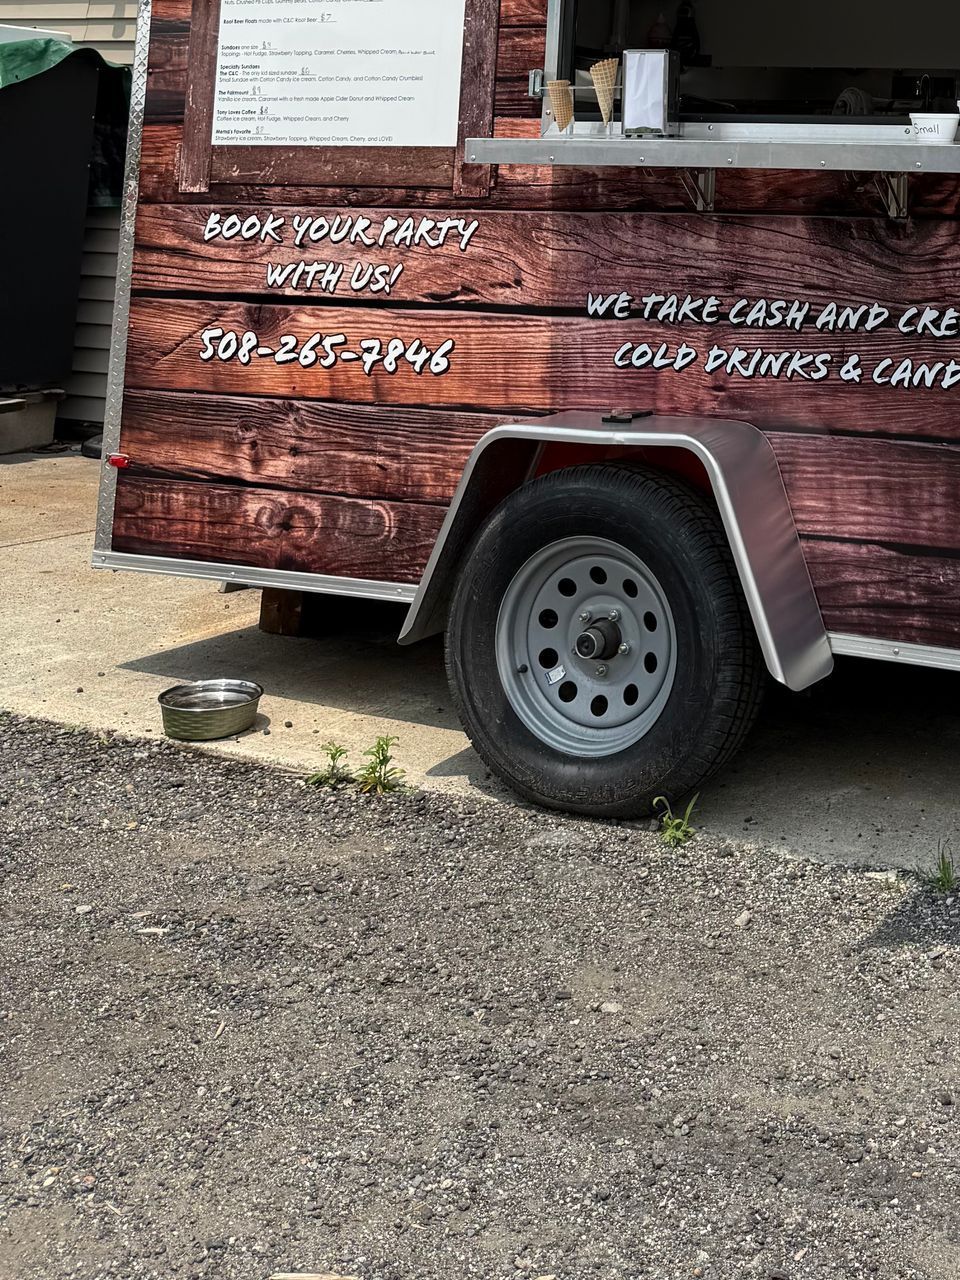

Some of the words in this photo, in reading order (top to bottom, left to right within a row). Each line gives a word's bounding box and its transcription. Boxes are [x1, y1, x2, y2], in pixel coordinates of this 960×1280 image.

[914, 122, 939, 135] Small
[204, 212, 284, 242] BOOK
[292, 214, 376, 247] YOUR
[379, 216, 479, 251] PARTY
[266, 262, 344, 293] WITH
[350, 262, 404, 294] US!
[586, 291, 635, 318] WE
[642, 292, 721, 323] TAKE
[728, 298, 811, 331] CASH
[815, 301, 889, 333] AND
[200, 327, 455, 375] 508-265-7846
[614, 341, 698, 371] COLD
[703, 345, 832, 381] DRINKS
[839, 354, 863, 382] &
